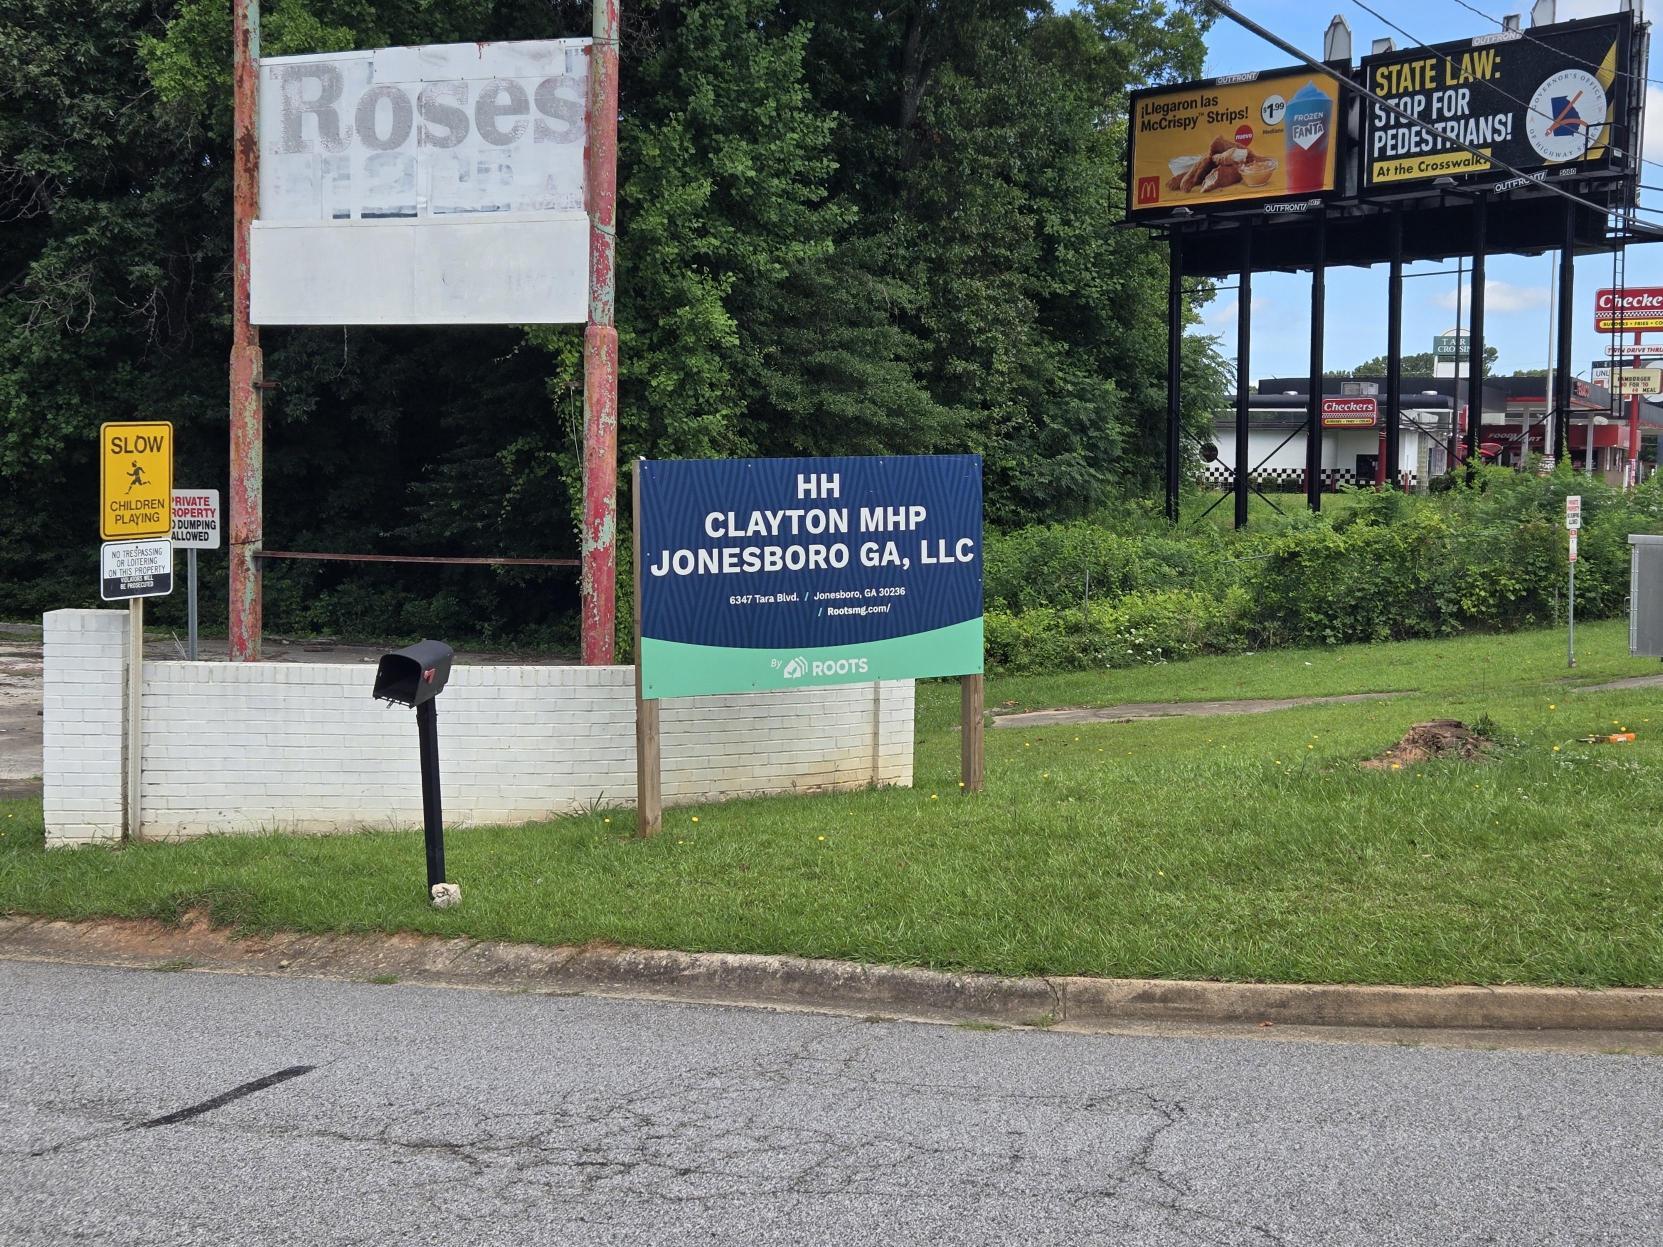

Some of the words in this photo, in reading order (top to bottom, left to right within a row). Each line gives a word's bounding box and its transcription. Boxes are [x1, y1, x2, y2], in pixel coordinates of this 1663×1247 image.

[1376, 58, 1437, 97] STATE
[1445, 49, 1501, 86] LAW:
[1531, 73, 1577, 110] GOVERNOR'S
[1580, 75, 1602, 99] OFFICE
[270, 63, 587, 153] Roses
[1141, 98, 1198, 119] ¡Llegaron
[1200, 95, 1218, 108] las
[1207, 106, 1249, 124] Strips!
[1263, 102, 1285, 118] $1.99
[1374, 94, 1426, 128] STOP
[1432, 88, 1470, 120] FOR
[1294, 112, 1323, 121] FROZEN
[1293, 122, 1324, 138] FANTA
[1373, 112, 1513, 158] PEDESTRIANS!
[1536, 142, 1573, 157] HIGHWAY
[1377, 165, 1390, 178] At
[1394, 162, 1413, 175] the
[1600, 293, 1663, 307] Checke
[1324, 402, 1373, 411] Checkers
[111, 435, 164, 454] SLOW
[797, 473, 840, 499] HH
[110, 499, 165, 512] CHILDREN
[172, 496, 210, 506] RIVATE
[115, 512, 160, 524] PLAYING
[172, 508, 216, 518] ROPERTY
[179, 520, 216, 530] DUMPING
[704, 508, 848, 538] CLAYTON
[860, 505, 927, 532] MHP
[171, 531, 209, 541] ALLOWED
[112, 551, 120, 559] NO
[123, 548, 162, 558] TRESPASSING
[650, 543, 849, 577] JONESBORO
[860, 541, 911, 570] GA,
[920, 537, 975, 564] LLC
[117, 559, 125, 567] OR
[127, 557, 157, 566] LOITERING
[108, 569, 117, 577] ON
[120, 568, 132, 576] THIS
[135, 565, 165, 575] PROPERTY
[729, 595, 752, 604] 6347
[754, 595, 774, 603] Tara
[777, 593, 799, 602] Blvd.
[813, 591, 862, 601] Jonesboro,
[864, 589, 877, 597] GA
[878, 587, 906, 597] 30236
[827, 603, 891, 616] Rootsmg.com/
[771, 658, 783, 670] By
[812, 658, 868, 676] ROOTS
